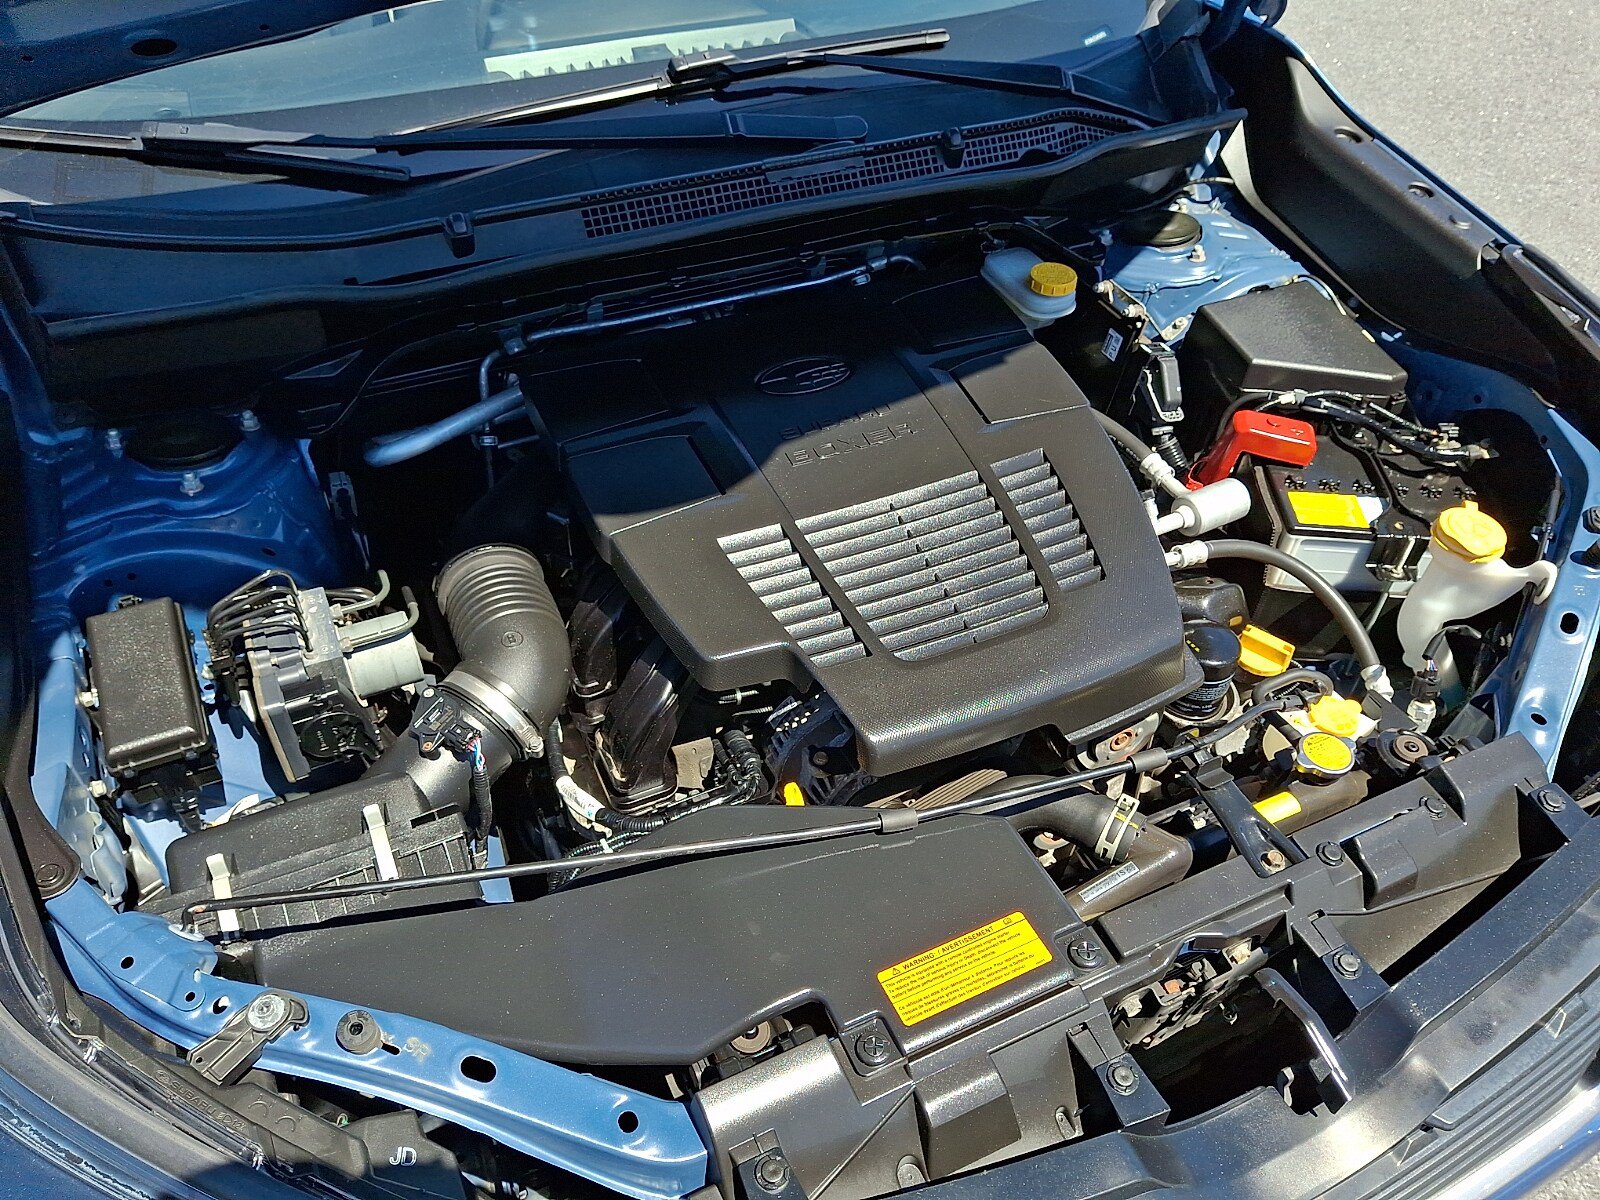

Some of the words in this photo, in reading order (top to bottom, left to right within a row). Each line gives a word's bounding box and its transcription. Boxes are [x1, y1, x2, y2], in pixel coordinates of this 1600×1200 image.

[784, 423, 920, 468] BOXER
[940, 926, 994, 953] AVERTISSEMENT
[170, 1081, 217, 1116] SUBARU
[389, 1146, 418, 1166] JD
